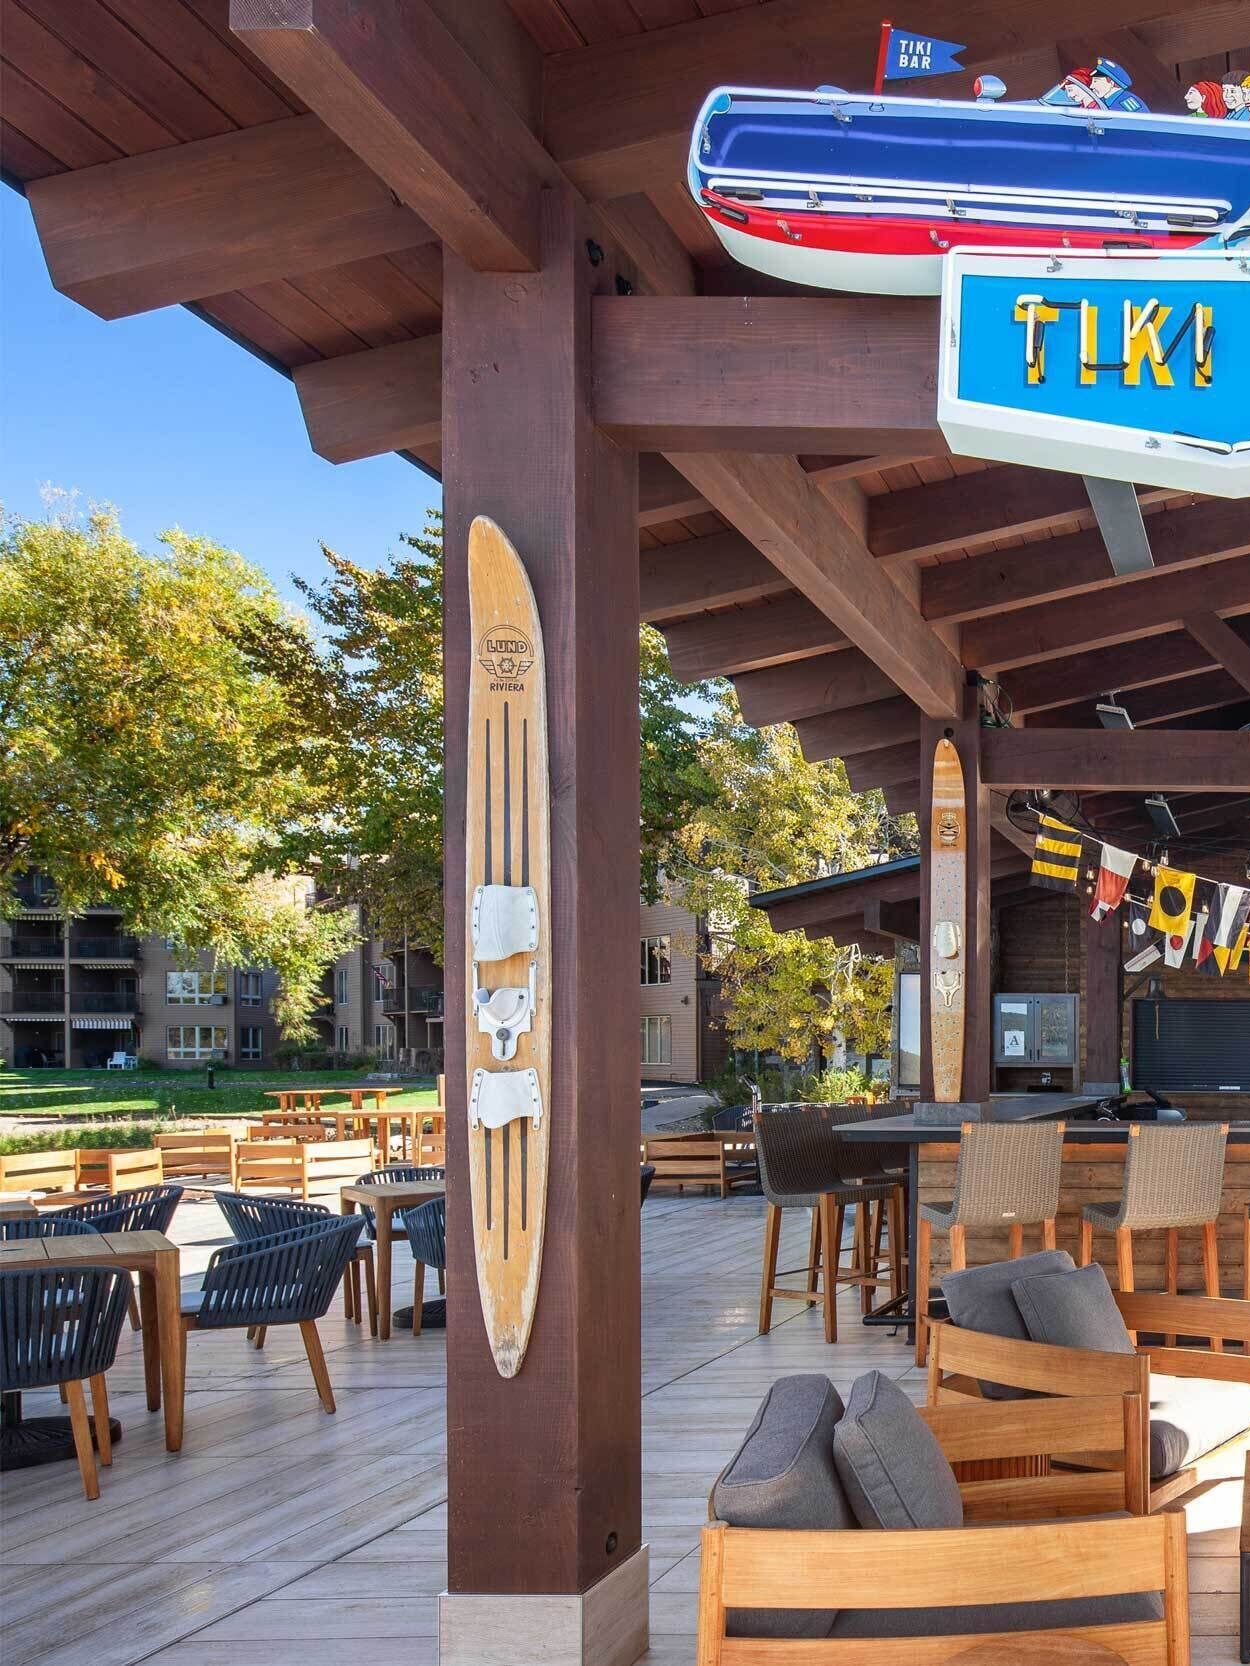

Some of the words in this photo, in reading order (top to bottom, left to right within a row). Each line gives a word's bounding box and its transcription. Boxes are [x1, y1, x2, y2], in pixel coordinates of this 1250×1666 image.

[899, 40, 932, 55] TIKI
[899, 55, 931, 69] BAR
[1014, 294, 1216, 388] TIKI
[486, 640, 527, 653] LUND
[489, 683, 524, 692] RIVIERA
